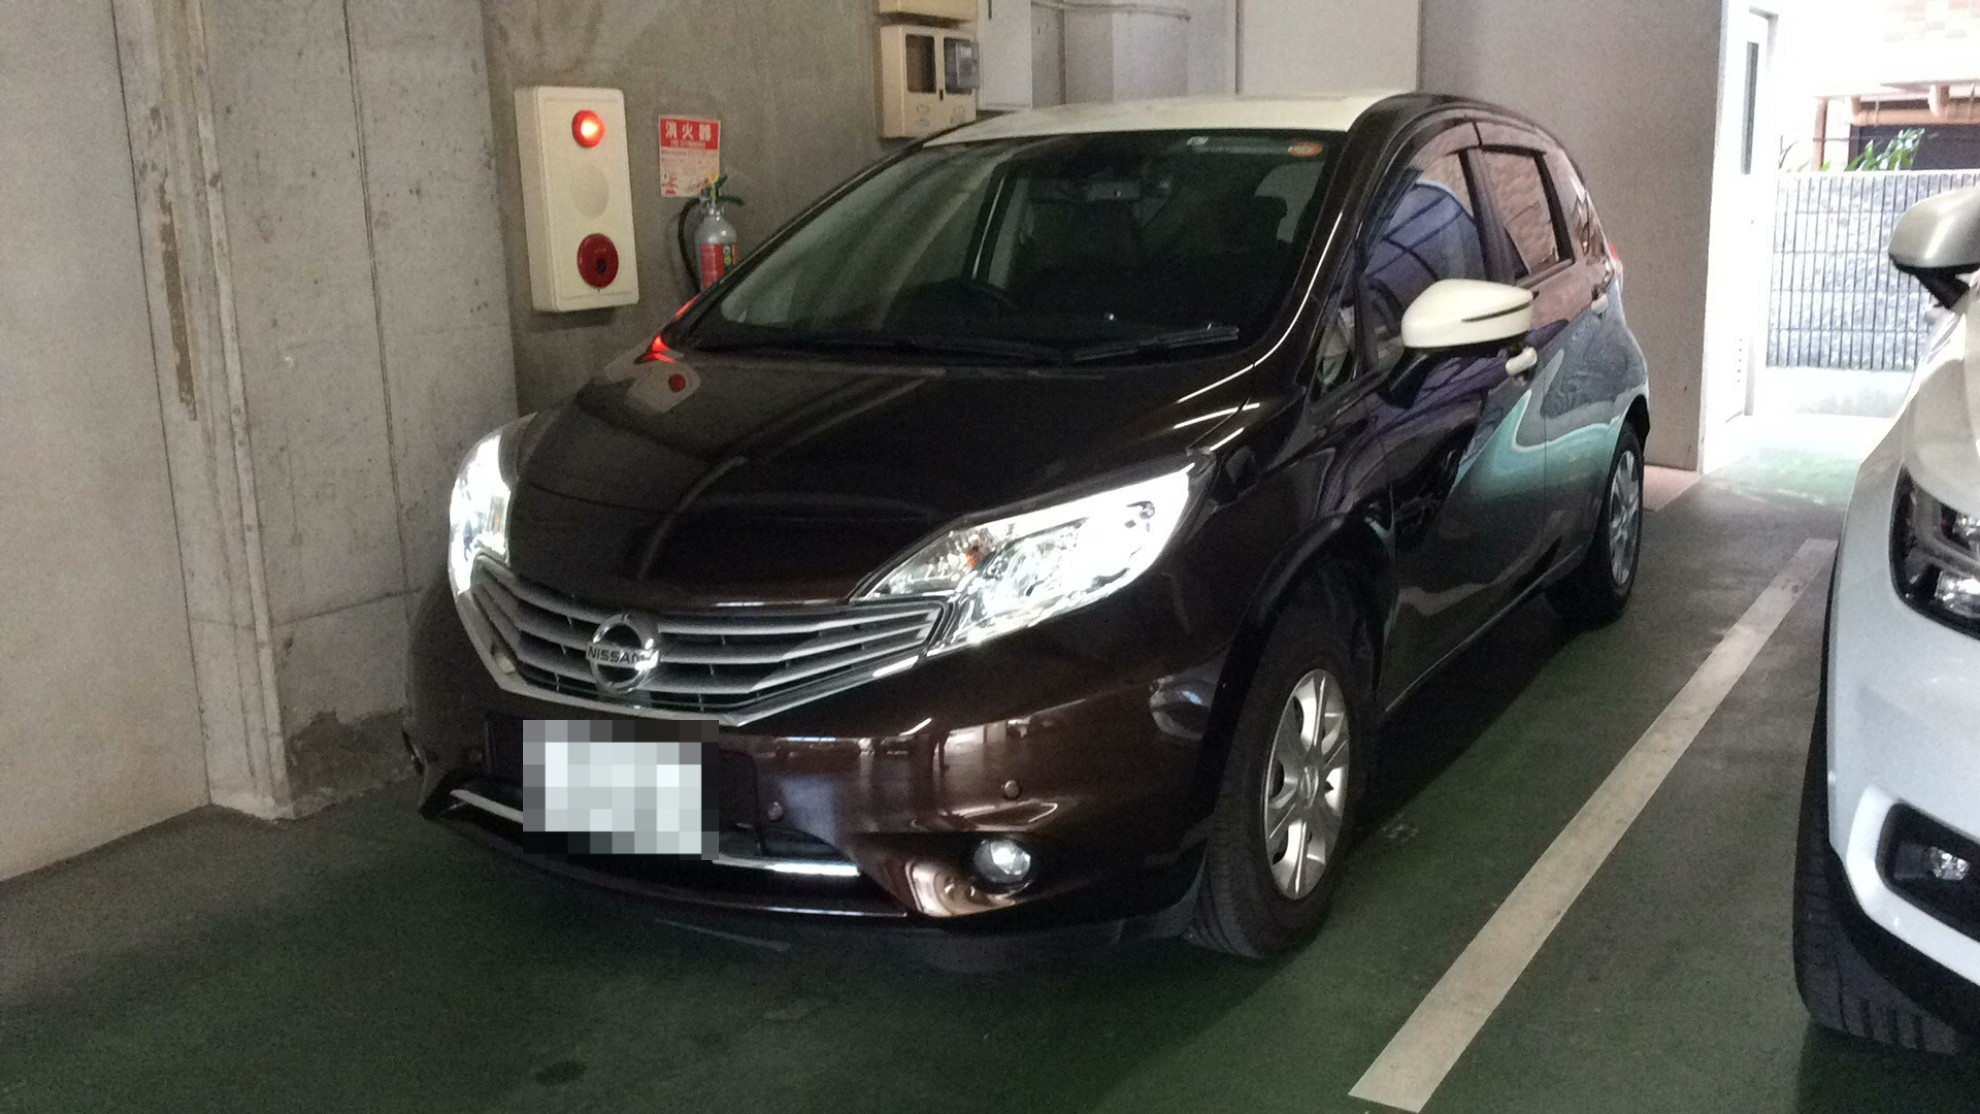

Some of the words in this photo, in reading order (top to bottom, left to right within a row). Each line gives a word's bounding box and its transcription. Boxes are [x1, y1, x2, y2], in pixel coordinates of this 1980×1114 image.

[665, 121, 712, 141] 消火器
[588, 645, 645, 664] NISSAN
